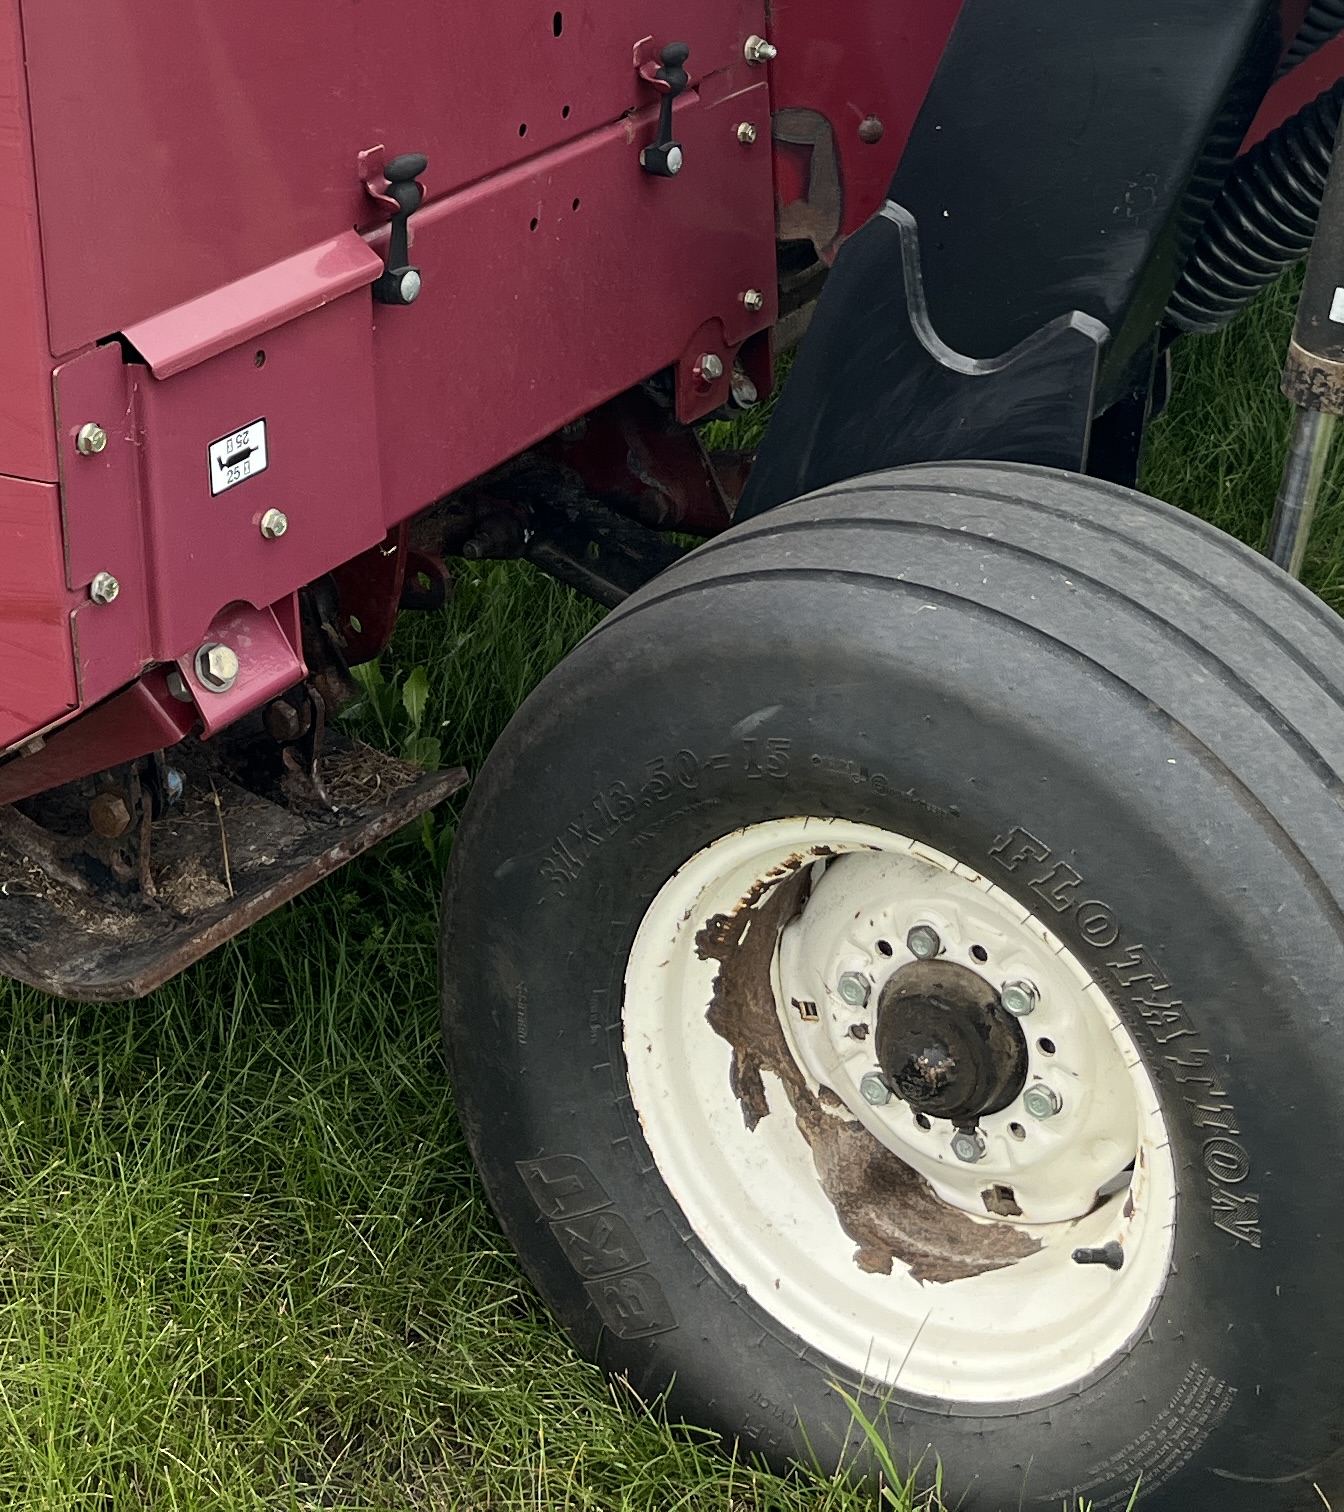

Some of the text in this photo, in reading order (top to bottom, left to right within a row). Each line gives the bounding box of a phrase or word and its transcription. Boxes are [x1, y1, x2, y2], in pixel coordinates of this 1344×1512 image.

[226, 465, 241, 485] 25
[987, 825, 1262, 1249] FLOTATION
[524, 1161, 662, 1338] BKT
